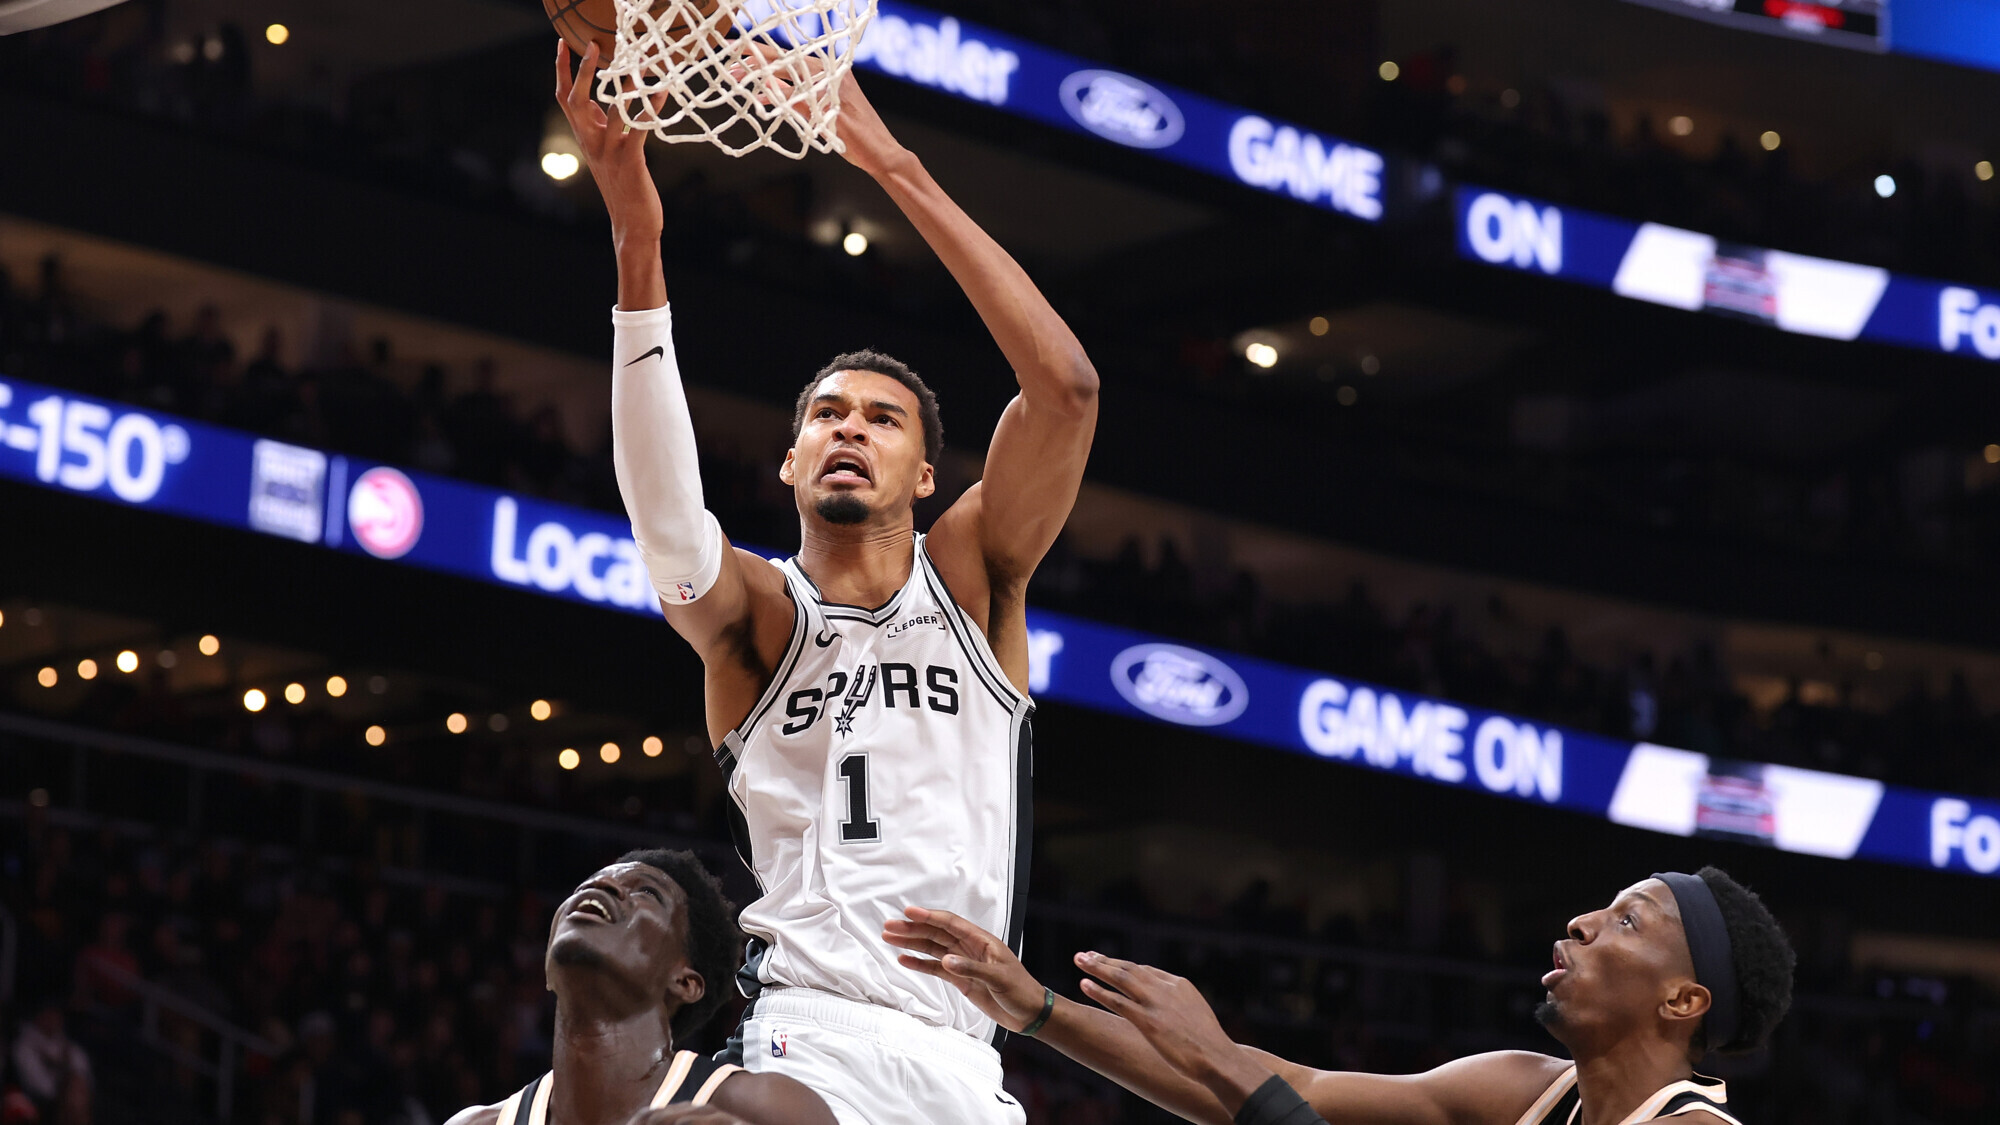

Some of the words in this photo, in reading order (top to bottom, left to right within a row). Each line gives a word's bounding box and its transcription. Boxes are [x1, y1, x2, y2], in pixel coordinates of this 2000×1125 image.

[1228, 115, 1384, 221] GAME
[1467, 193, 1563, 274] ON
[491, 496, 663, 615] Loca
[894, 615, 938, 633] LEDGER
[782, 662, 959, 736] SPURS
[1299, 678, 1468, 783] GAME
[1474, 716, 1563, 802] ON
[836, 751, 882, 845] 1
